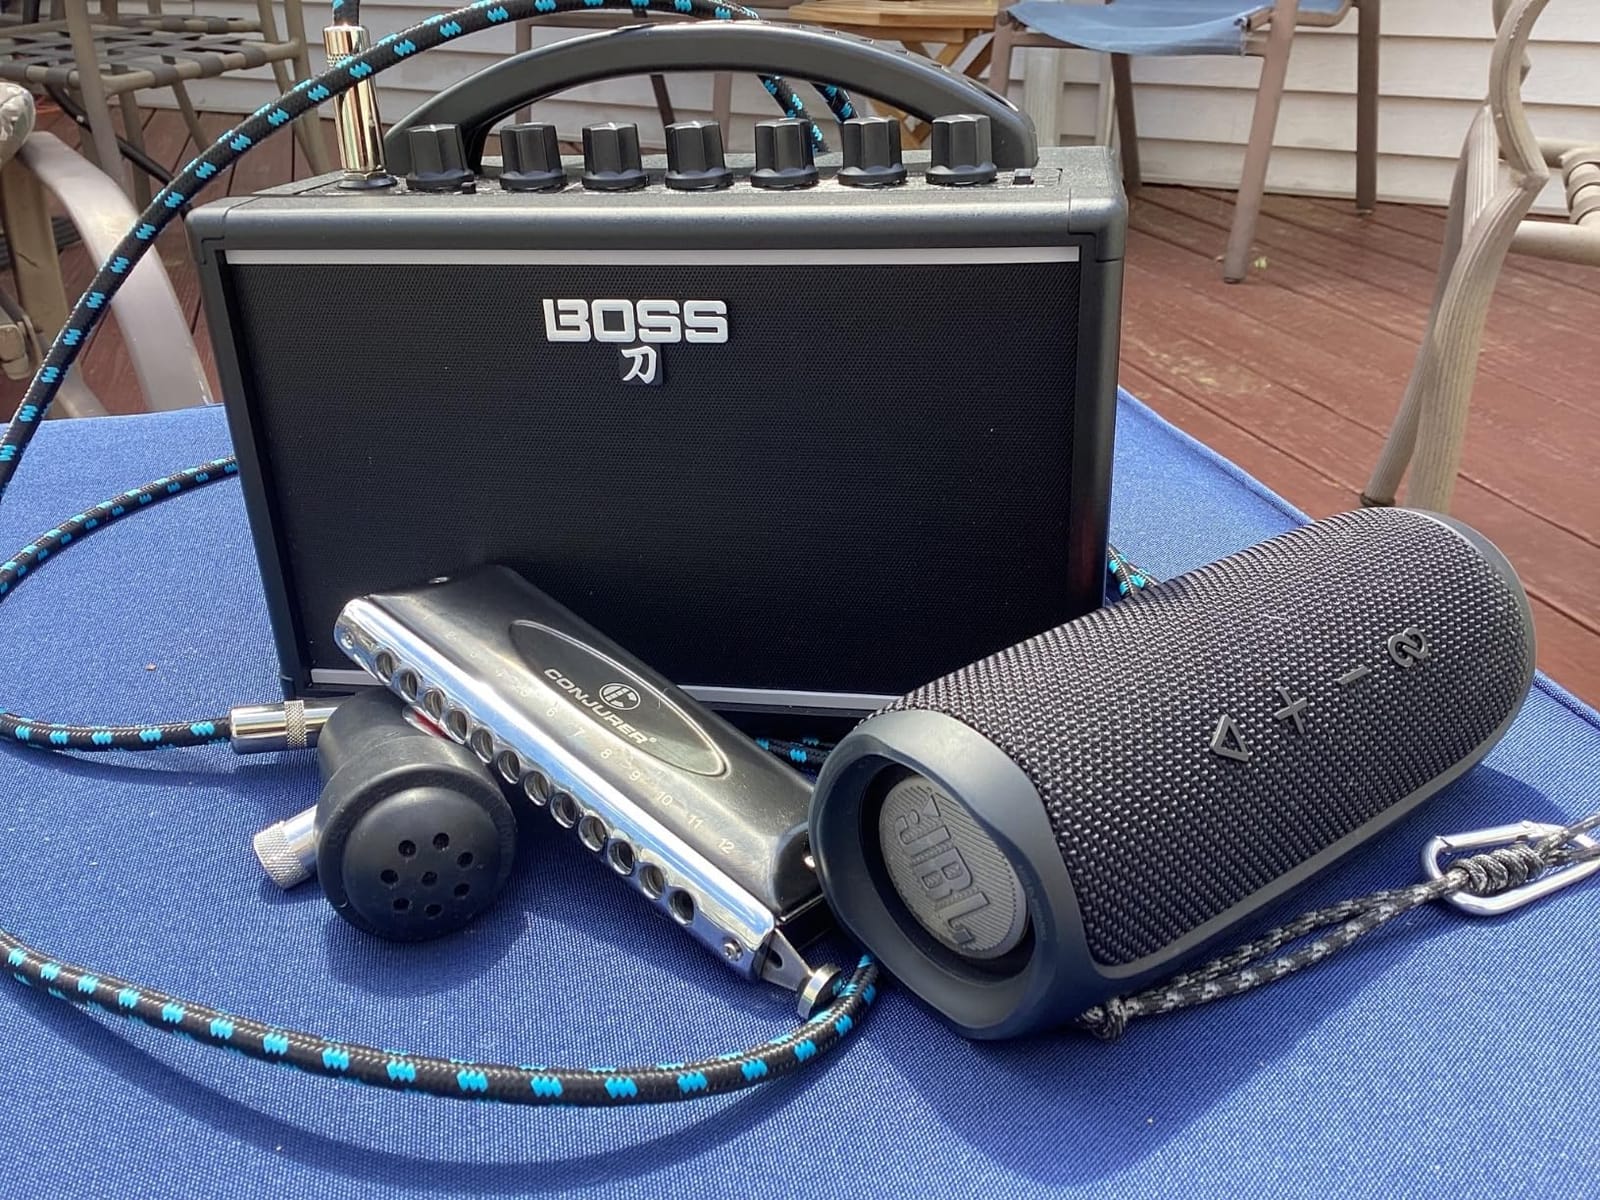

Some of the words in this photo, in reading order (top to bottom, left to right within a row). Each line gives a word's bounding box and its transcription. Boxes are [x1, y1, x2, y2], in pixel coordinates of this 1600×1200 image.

[541, 298, 729, 343] BOSS
[620, 345, 657, 384] 刀
[600, 748, 612, 760] 8
[629, 770, 641, 781] 9
[656, 791, 673, 806] 10
[687, 814, 704, 829] 11
[718, 838, 735, 854] 12
